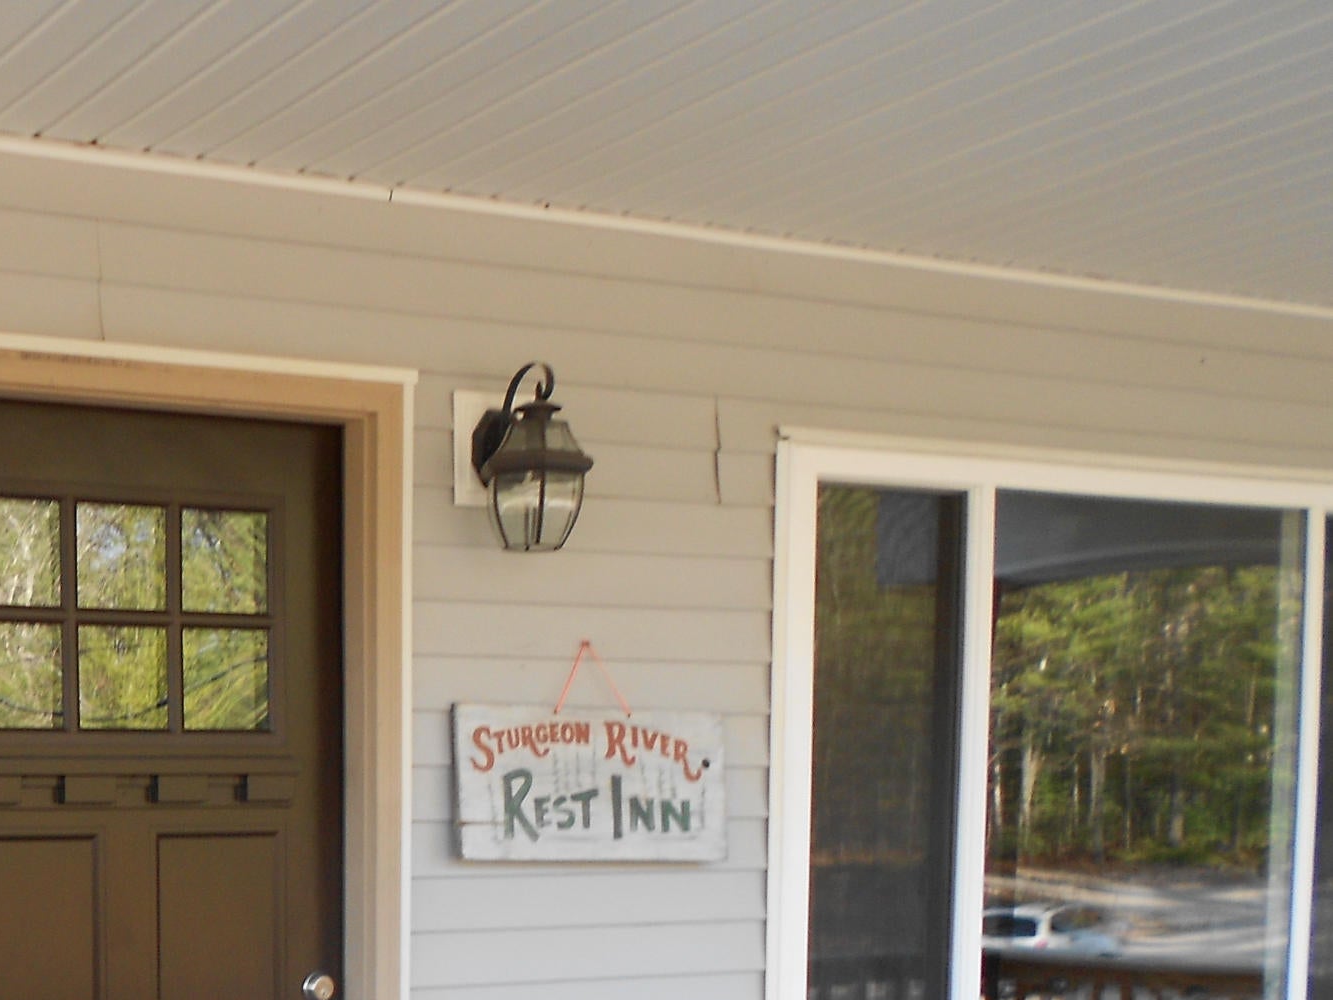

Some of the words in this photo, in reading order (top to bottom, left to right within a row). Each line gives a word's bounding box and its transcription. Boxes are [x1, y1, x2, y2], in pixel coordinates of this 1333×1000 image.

[470, 721, 590, 772] STURGEON
[604, 721, 702, 782] RIVER
[502, 768, 599, 842] REST
[611, 775, 691, 840] INN
